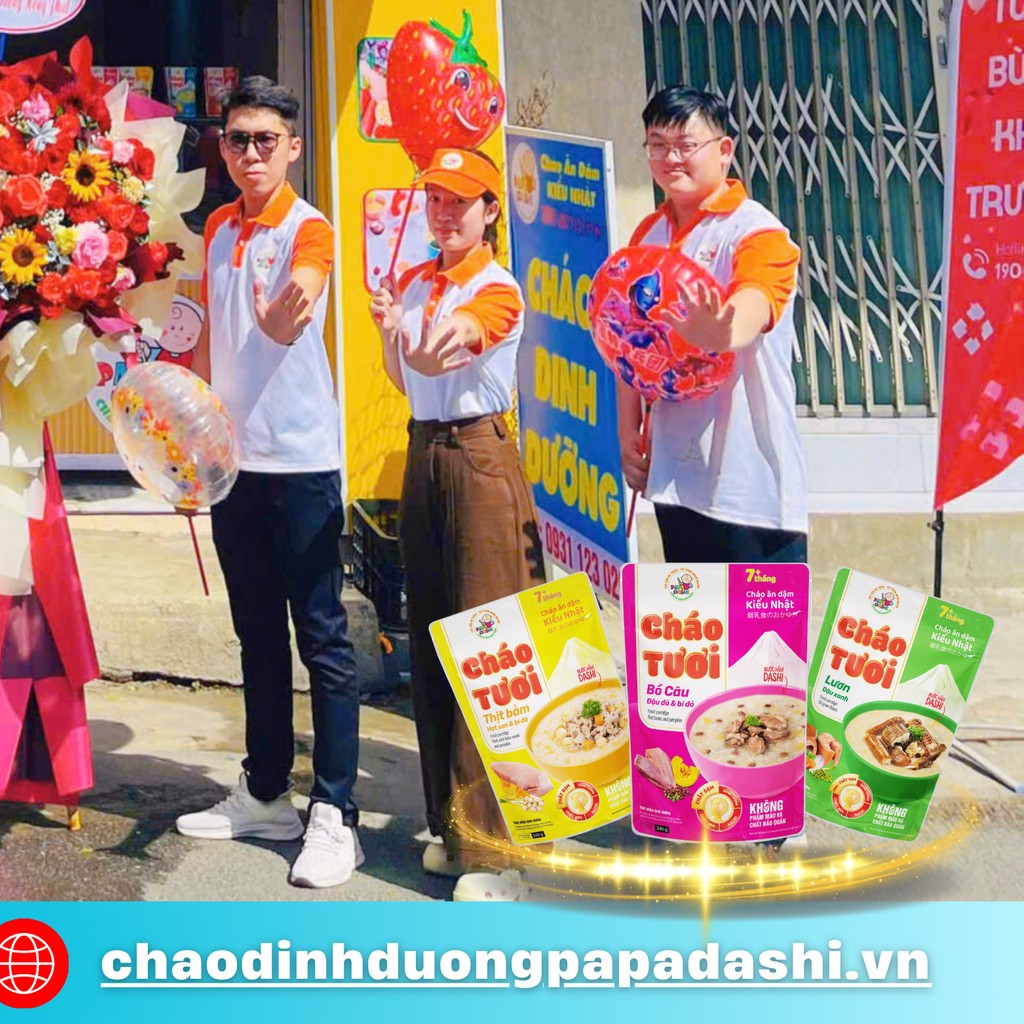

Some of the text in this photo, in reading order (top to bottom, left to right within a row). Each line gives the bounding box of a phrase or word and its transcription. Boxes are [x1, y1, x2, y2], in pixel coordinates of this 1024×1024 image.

[534, 346, 598, 427] DINH
[525, 427, 620, 533] DƯỠNG
[545, 521, 573, 569] 0931
